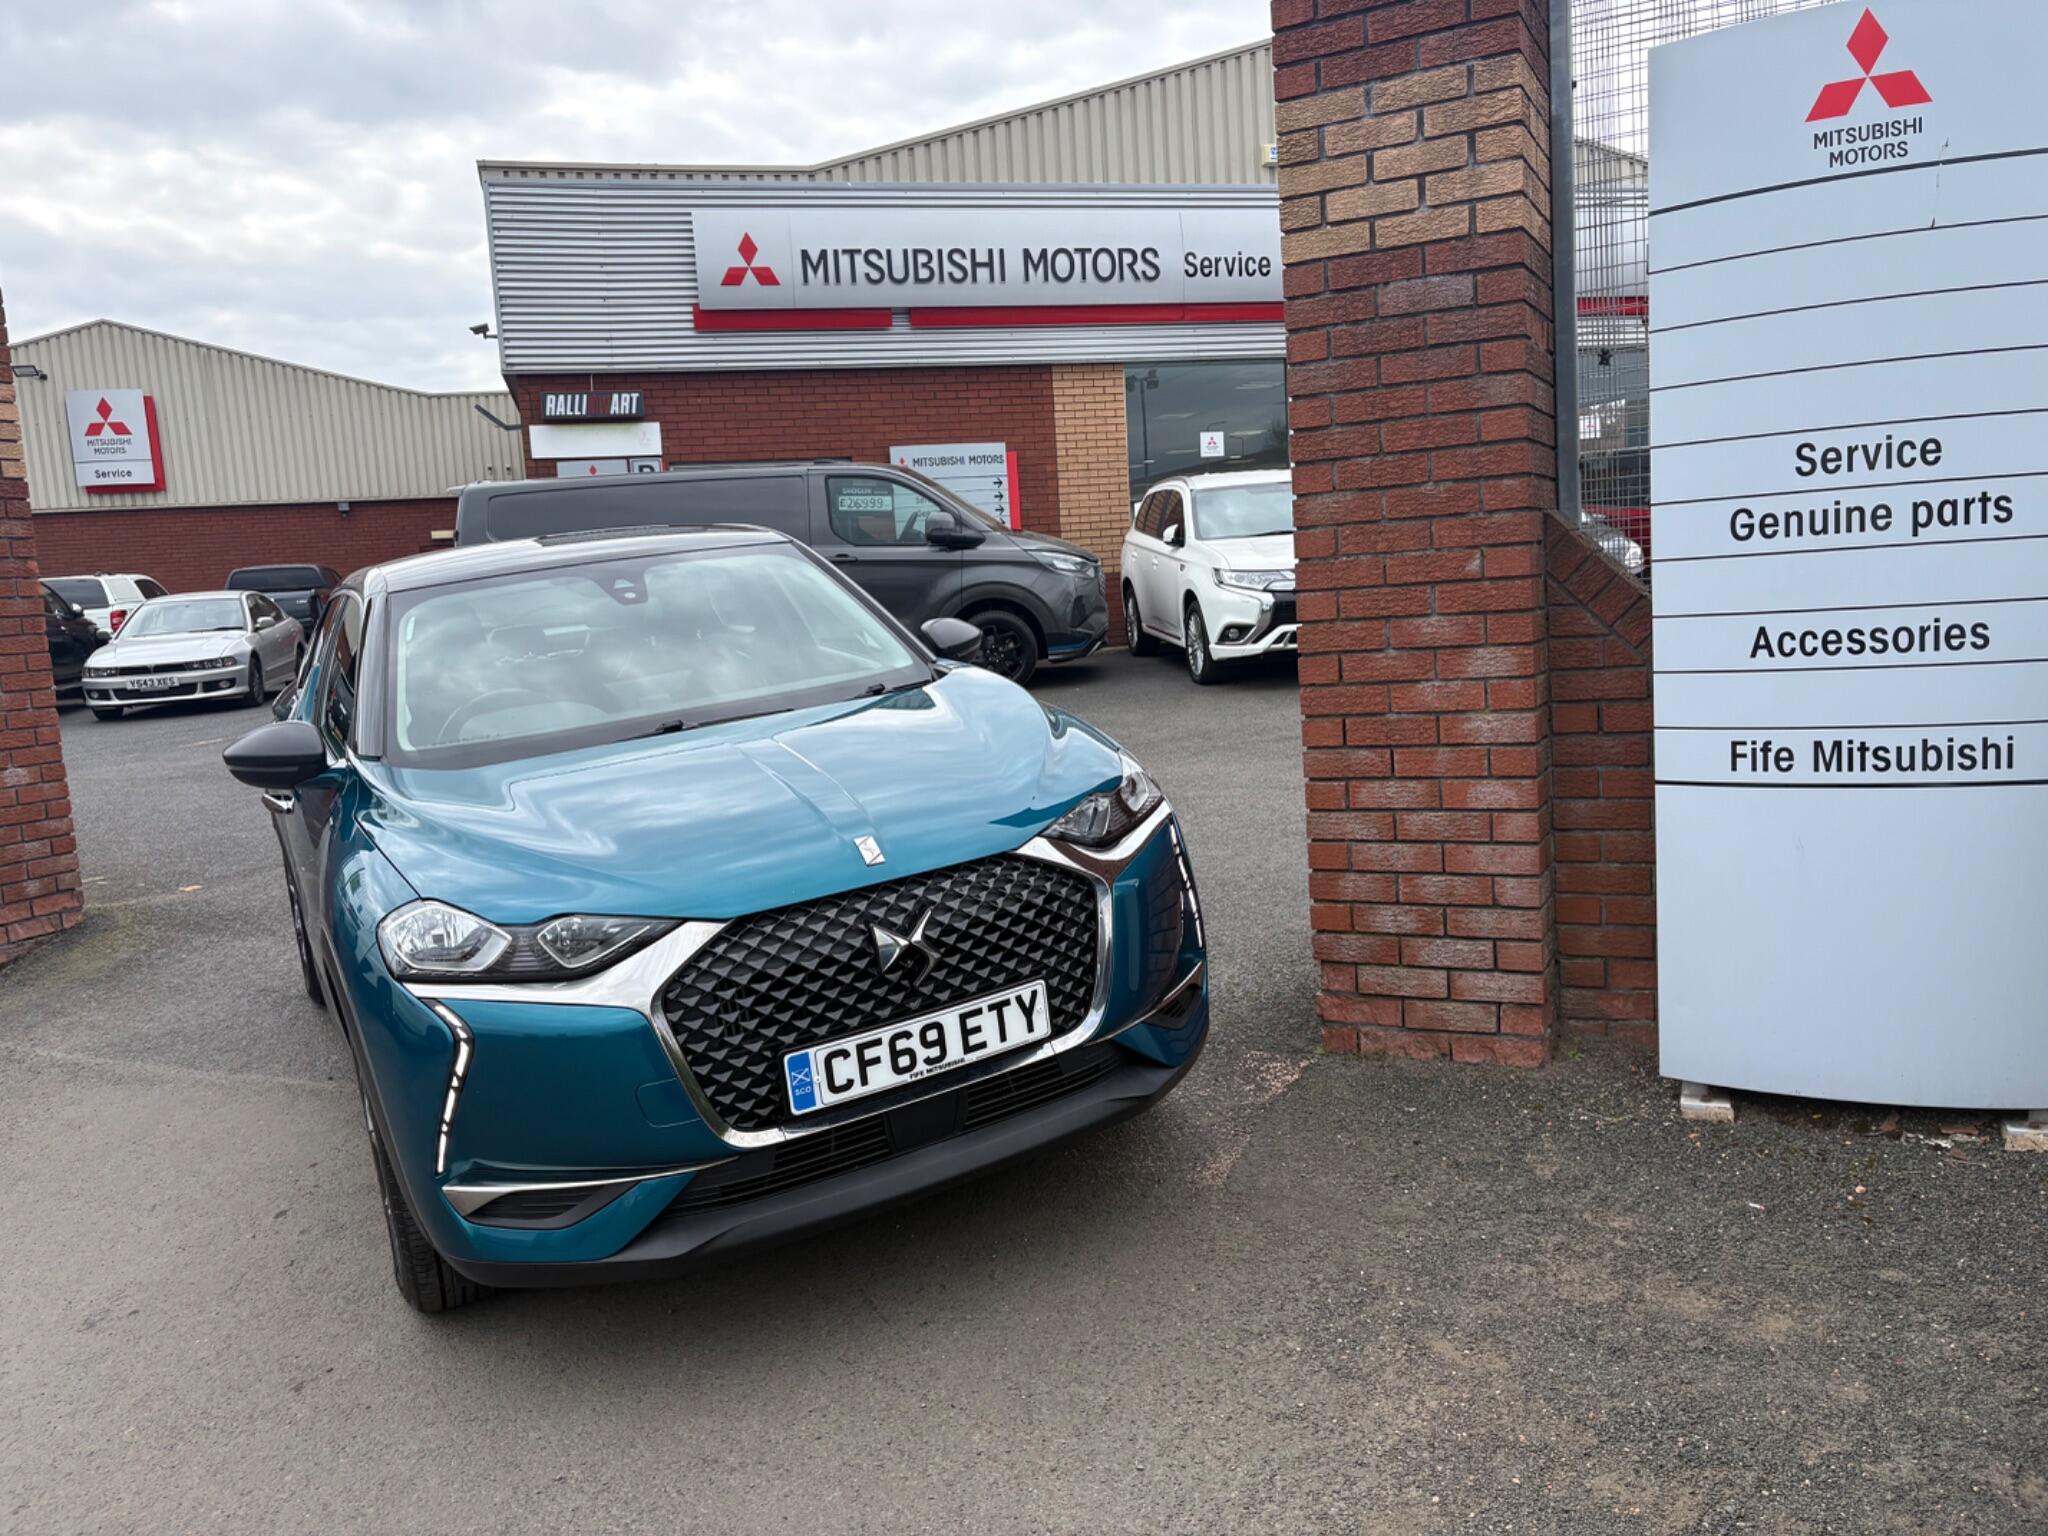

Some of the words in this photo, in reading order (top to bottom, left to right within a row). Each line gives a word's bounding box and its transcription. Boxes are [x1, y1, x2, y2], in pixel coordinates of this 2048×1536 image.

[1813, 116, 1923, 150] MITSUBISHI
[1828, 141, 1909, 168] MOTORS
[800, 247, 1006, 286] MITSUBISHI
[1022, 247, 1161, 283] MOTORS
[1183, 250, 1272, 278] Service
[545, 394, 588, 416] RALLI
[610, 393, 639, 415] ART
[87, 438, 132, 447] MITSUBISHI
[93, 446, 127, 455] MOTORS
[1794, 434, 1943, 477] Service
[94, 468, 133, 479] Service
[912, 456, 965, 467] MITSUBISHI
[968, 454, 1004, 465] MOTORS
[1729, 500, 1893, 542] Genuine
[1911, 491, 2014, 537] parts
[1749, 618, 1991, 659] Accessories
[1729, 740, 1795, 772] Fife
[1812, 735, 2015, 773] Mitsubishi
[824, 1021, 948, 1095] CF69
[958, 989, 1038, 1055] ETY
[794, 1085, 812, 1097] SCO
